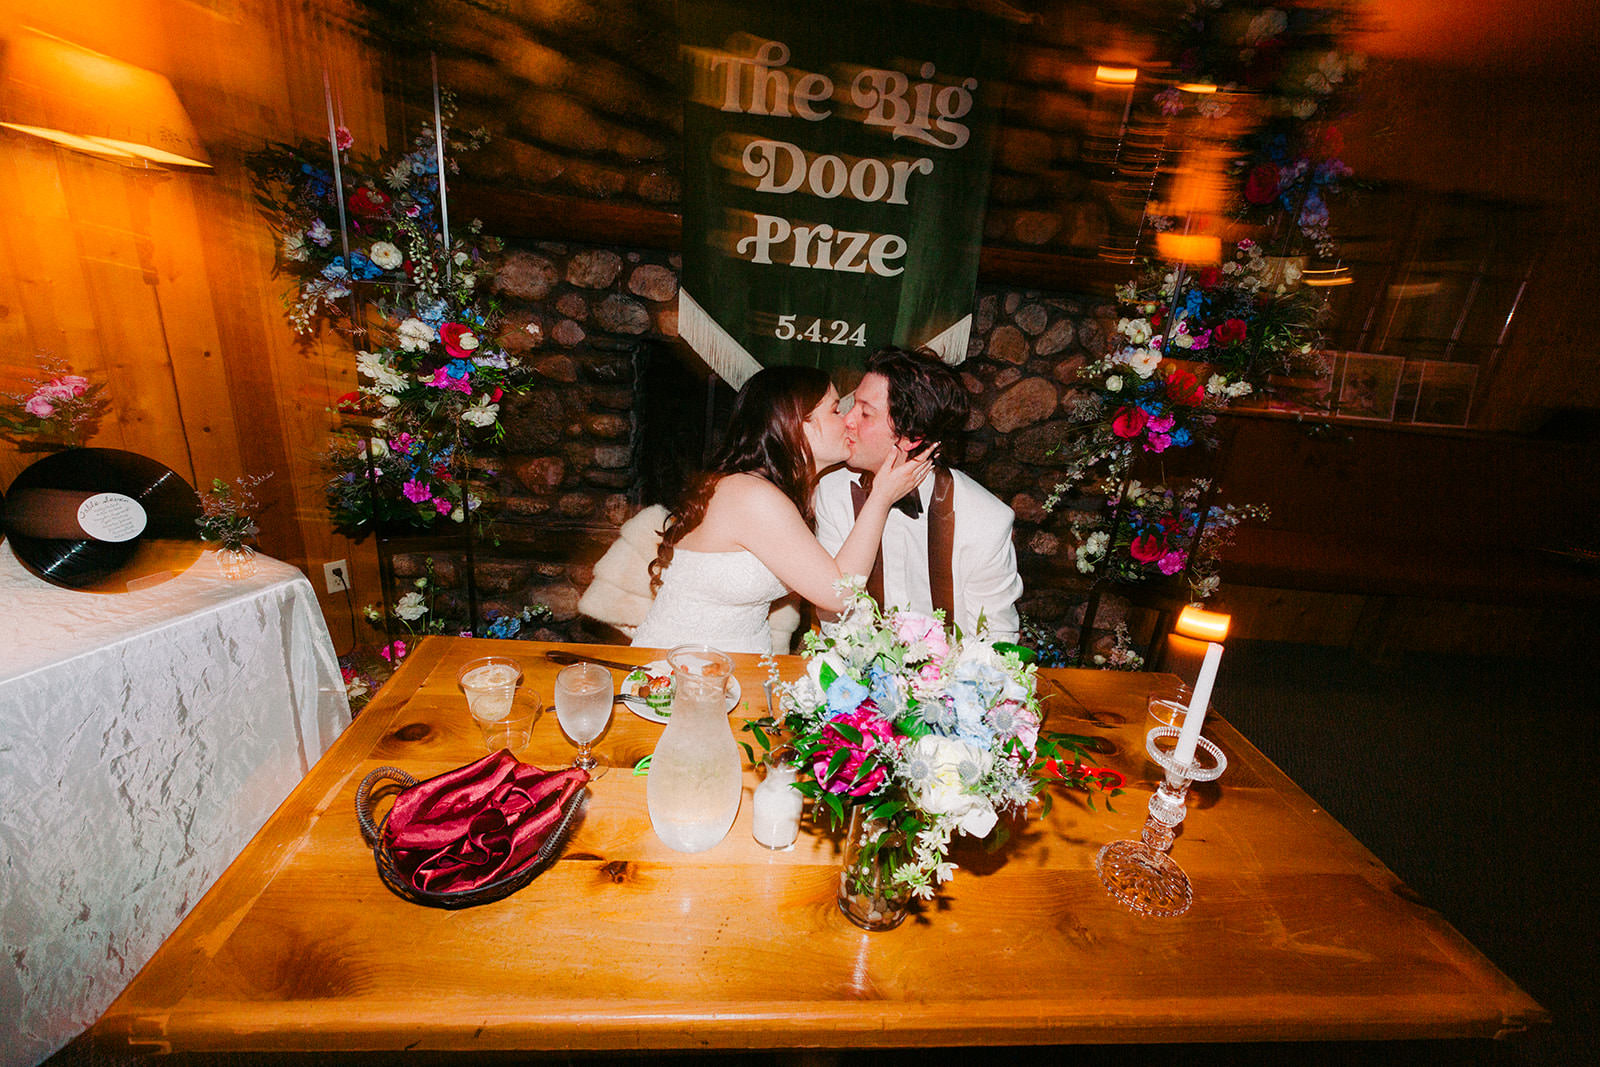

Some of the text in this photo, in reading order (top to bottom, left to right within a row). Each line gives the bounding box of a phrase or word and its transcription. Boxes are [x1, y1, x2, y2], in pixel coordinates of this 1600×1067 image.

[710, 41, 978, 150] The Big
[742, 140, 934, 205] Door
[736, 214, 908, 277] Prize
[774, 314, 867, 347] 5.4.24
